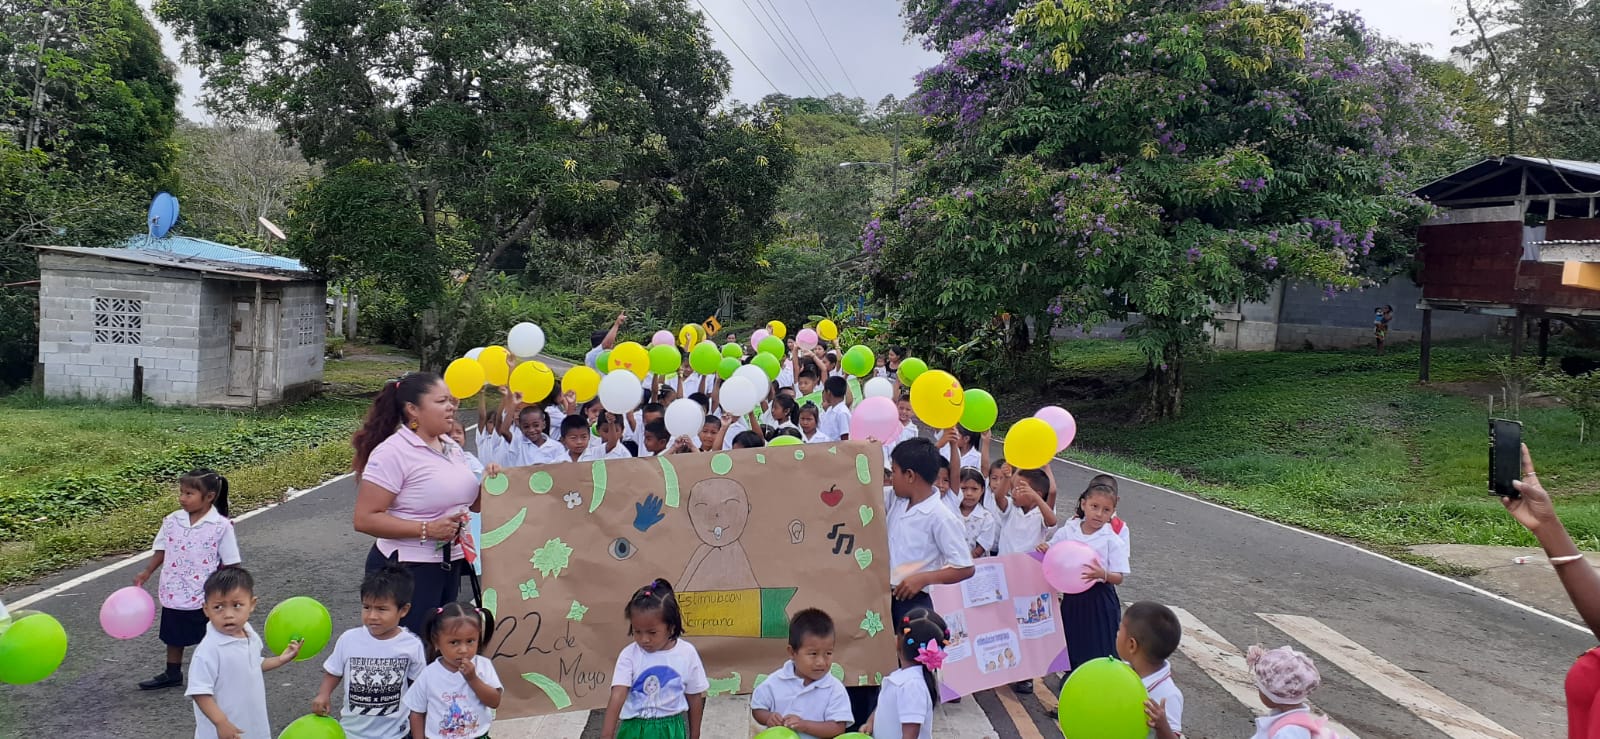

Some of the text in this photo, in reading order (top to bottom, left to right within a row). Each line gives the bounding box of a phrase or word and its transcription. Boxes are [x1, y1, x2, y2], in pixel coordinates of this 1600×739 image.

[491, 611, 576, 660] 22 de
[558, 652, 605, 698] Mayo
